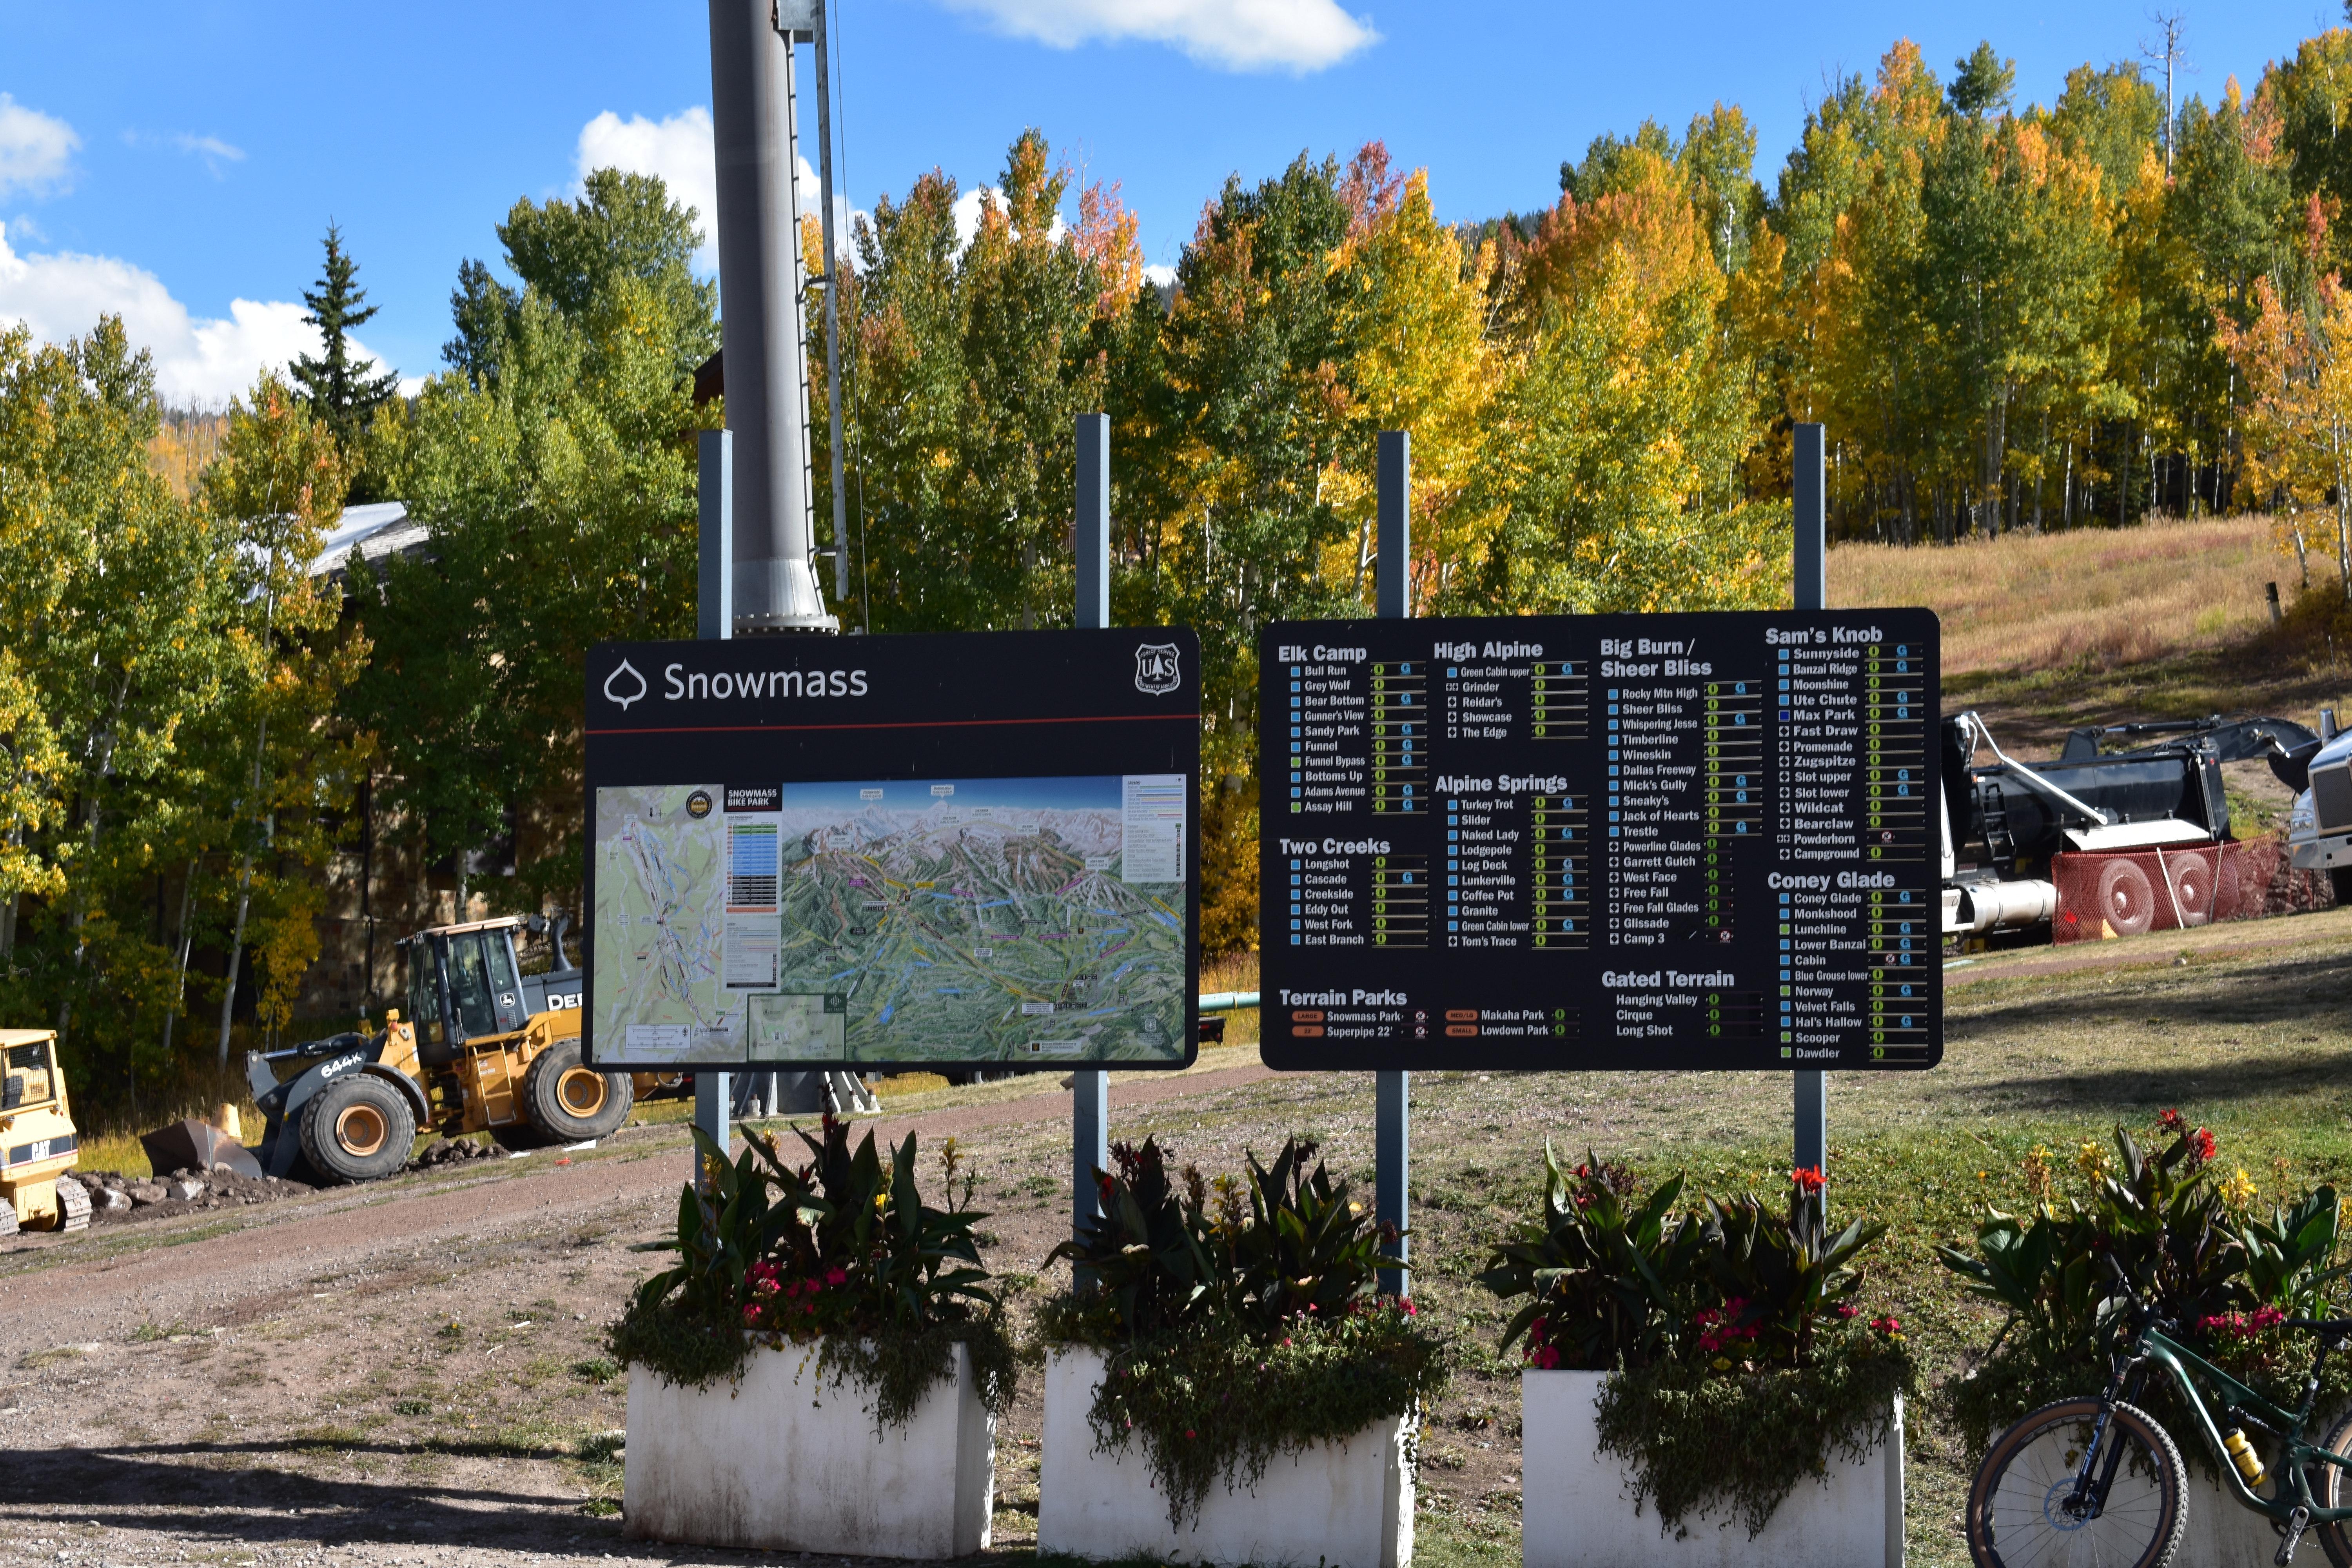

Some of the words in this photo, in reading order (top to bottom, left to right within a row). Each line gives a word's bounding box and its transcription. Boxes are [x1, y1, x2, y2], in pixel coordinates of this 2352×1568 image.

[1765, 627, 1826, 645] Sam's
[1833, 626, 1883, 643] Knob
[1140, 650, 1156, 659] FOREST
[1158, 649, 1175, 658] SERVICE
[1279, 645, 1308, 662] Elk
[1313, 644, 1367, 664] Camp
[1434, 642, 1476, 662] High
[1482, 641, 1543, 661] Alpine
[1601, 639, 1632, 659] Big
[1638, 638, 1683, 655] Burn
[1793, 647, 1859, 661] Sunnyside
[1142, 659, 1152, 677] U
[1164, 659, 1174, 677] S
[1305, 665, 1324, 676] Bull
[1327, 665, 1346, 676] Run
[1601, 661, 1659, 678] Sheer
[1664, 659, 1712, 676] Bliss
[664, 663, 868, 701] Snowmass
[1305, 681, 1327, 693] Grey
[1328, 679, 1350, 691] Wolf
[1463, 681, 1500, 693] Grinder
[1793, 678, 1849, 691] Moonshine
[1622, 688, 1651, 701] Rocky
[1654, 688, 1673, 699] Mtn
[1676, 687, 1698, 701] High
[1793, 694, 1815, 706] Ute
[1819, 694, 1857, 706] Chute
[1305, 695, 1328, 706] Bear
[1330, 695, 1364, 706] Bottom
[1463, 696, 1502, 708] Reidar's
[1622, 704, 1654, 715] Sheer
[1657, 703, 1682, 714] Bliss
[1793, 710, 1820, 721] Max
[1825, 709, 1855, 720] Park
[1305, 710, 1342, 722] Gunner's
[1344, 710, 1365, 721] View
[1463, 712, 1512, 723] Showcase
[1305, 725, 1335, 739] Sandy
[1338, 725, 1360, 736] Park
[1462, 727, 1480, 738] The
[1483, 726, 1507, 740] Edge
[1793, 725, 1821, 737] Fast
[1826, 725, 1858, 736] Draw
[1622, 733, 1679, 745] Timberline
[1305, 740, 1338, 751] Funnel
[1793, 740, 1853, 753] Promenade
[1622, 749, 1671, 760] Wineskin
[1794, 755, 1856, 769] Zugspitze
[1305, 771, 1346, 782] Bottoms
[1349, 770, 1363, 783] Up
[1623, 764, 1654, 776] Dallas
[1657, 764, 1696, 777] Freeway
[1795, 771, 1817, 782] Slot
[1820, 773, 1852, 784] upper
[1435, 775, 1492, 795] Alpine
[1498, 774, 1568, 795] Springs
[1623, 780, 1657, 791] Mick's
[1661, 779, 1687, 793] Gully
[728, 789, 777, 798] SNOWMASS
[728, 798, 746, 806] BIKE
[748, 797, 769, 806] PARK
[1305, 801, 1333, 814] Assay
[1336, 800, 1352, 811] Hill
[1461, 799, 1493, 812] Turkey
[1494, 799, 1514, 810] Trot
[1623, 795, 1669, 808] Sneaky's
[1795, 802, 1844, 814] Wildcat
[1461, 814, 1491, 826] Slider
[1622, 811, 1647, 822] Jack
[1650, 810, 1661, 821] of
[1664, 810, 1699, 821] Hearts
[1794, 818, 1854, 829] Bearclaw
[1462, 829, 1493, 840] Naked
[1496, 829, 1519, 842] Lady
[1622, 826, 1658, 837] Trestle
[1794, 833, 1855, 845] Powderhorn
[1279, 838, 1317, 855] Two
[1323, 837, 1390, 855] Creeks
[1462, 844, 1512, 858] Lodgepole
[1623, 841, 1667, 852] Powerline
[1670, 840, 1701, 851] Glades
[1794, 847, 1859, 861] Campground
[1305, 858, 1350, 871] Longshot
[1462, 860, 1480, 873] Log
[1483, 859, 1508, 871] Deck
[1623, 856, 1662, 867] Garrett
[1665, 856, 1695, 867] Gulch
[1305, 873, 1347, 885] Cascade
[1462, 875, 1515, 886] Lunkerville
[1623, 872, 1650, 883] West
[1653, 871, 1677, 882] Face
[1768, 872, 1831, 892] Coney
[1837, 871, 1895, 888] Glade
[1305, 889, 1354, 900] Creekside
[1462, 890, 1494, 901] Coffee
[1497, 890, 1514, 901] Pot
[1624, 887, 1647, 898] Free
[1650, 887, 1668, 898] Fall
[1794, 893, 1827, 906] Coney
[1830, 892, 1862, 904] Glade
[1305, 904, 1328, 917] Eddy
[1331, 904, 1348, 915] Out
[1462, 905, 1498, 916] Granite
[1795, 908, 1857, 919] Monkshood
[1305, 919, 1329, 930] West
[1332, 919, 1353, 930] Fork
[1624, 917, 1669, 929] Glissade
[1795, 924, 1847, 935] Lunchline
[1305, 934, 1327, 945] East
[1330, 934, 1364, 945] Branch
[1461, 936, 1489, 947] Tom's
[1490, 936, 1517, 947] Trace
[1624, 933, 1654, 946] Camp
[1658, 933, 1665, 943] 3
[1795, 939, 1827, 950] Lower
[1830, 939, 1866, 950] Banzai
[1795, 955, 1826, 966] Cabin
[1602, 970, 1661, 988] Gated
[1666, 969, 1734, 987] Terrain
[1279, 989, 1346, 1006] Terrain
[1352, 989, 1407, 1006] Parks
[1795, 986, 1833, 999] Norway
[1616, 994, 1663, 1007] Hanging
[1665, 994, 1698, 1007] Valley
[1795, 1001, 1828, 1012] Velvet
[1831, 1001, 1855, 1012] Falls
[1327, 1011, 1376, 1022] Snowmass
[1379, 1011, 1401, 1022] Park
[1481, 1009, 1519, 1021] Makaha
[1523, 1009, 1544, 1020] Park
[1616, 1009, 1653, 1023] Cirque
[1796, 1016, 1822, 1028] Hal's
[1826, 1016, 1862, 1027] Hallow
[1327, 1026, 1374, 1039] Superpipe
[1377, 1026, 1393, 1037] 22'
[1481, 1025, 1524, 1036] Lowdown
[1527, 1025, 1548, 1036] Park
[1617, 1025, 1644, 1038] Long
[1647, 1025, 1673, 1036] Shot
[1796, 1032, 1840, 1045] Scooper
[1796, 1048, 1840, 1059] Dawdler
[321, 1051, 362, 1078] 644K
[32, 1140, 50, 1163] CAT
